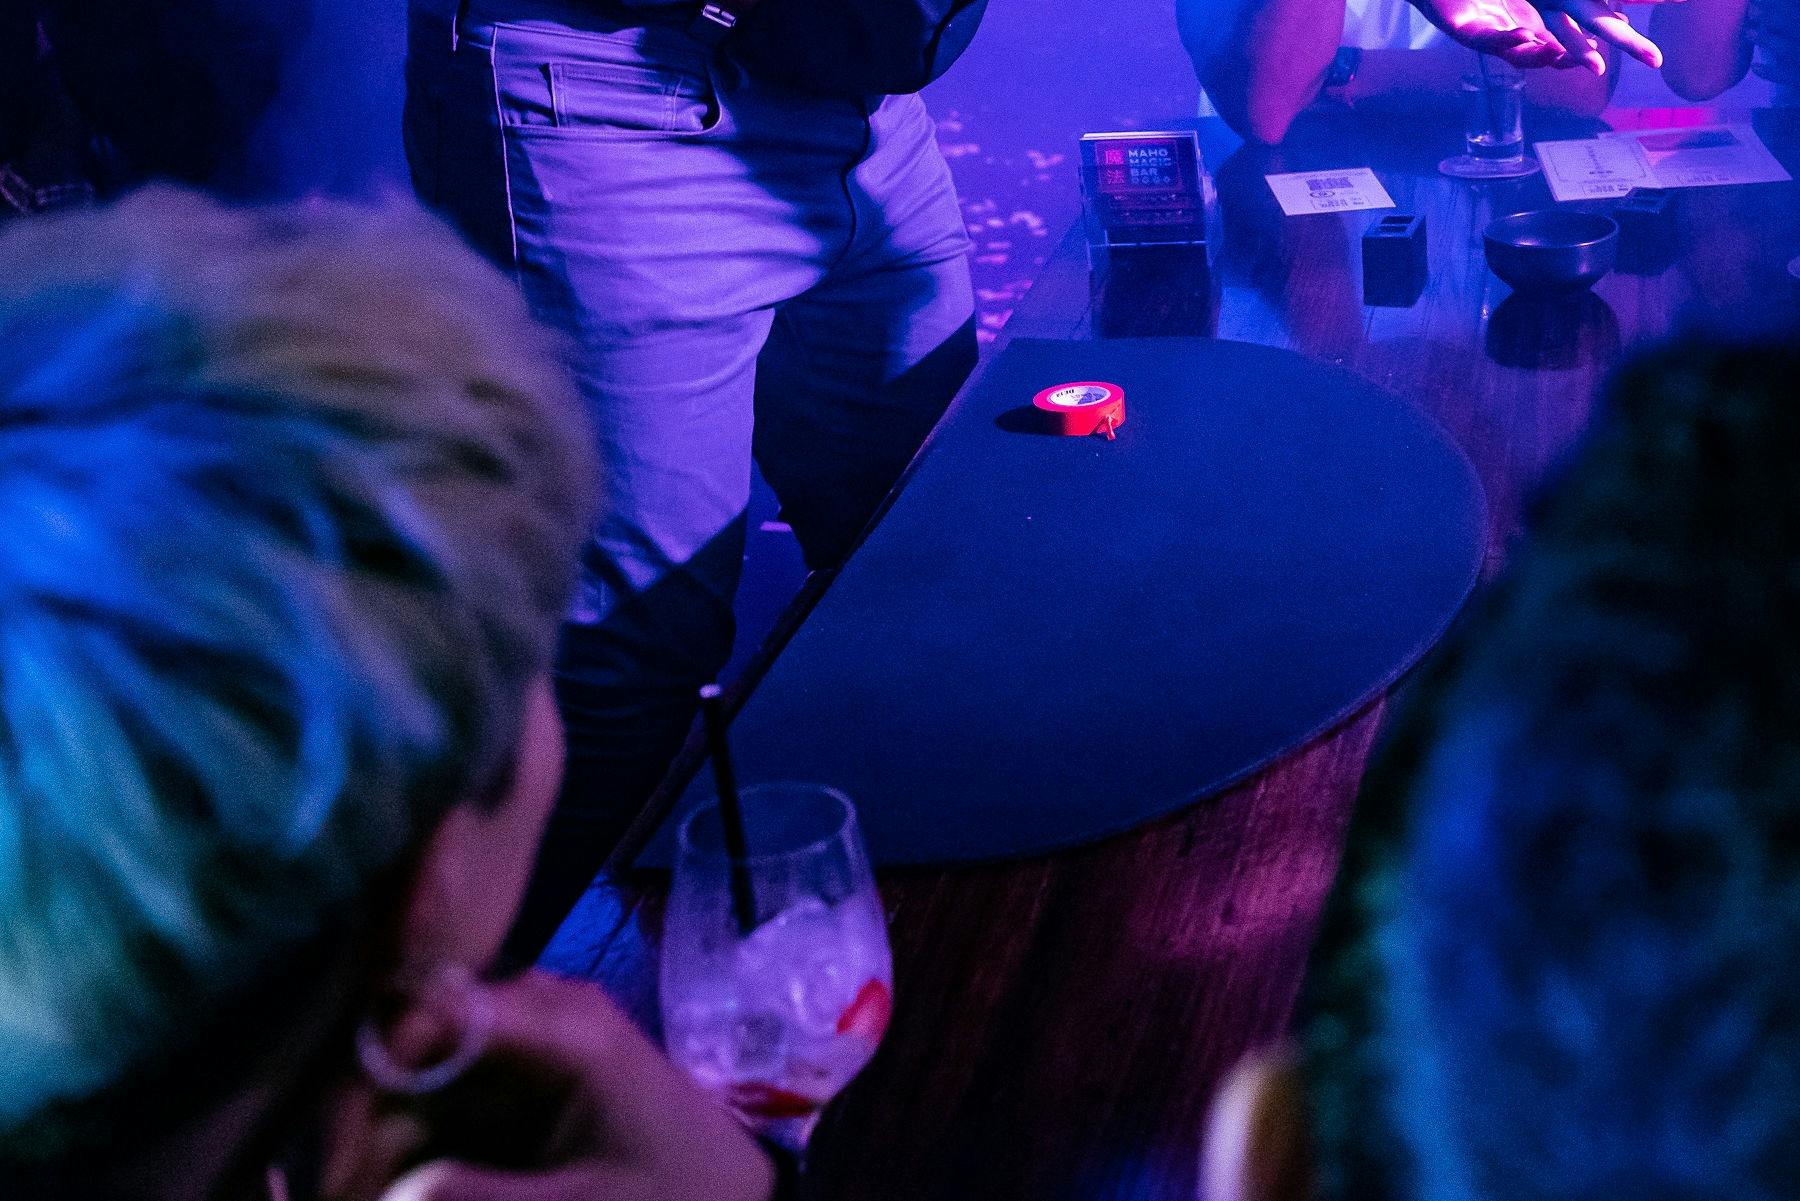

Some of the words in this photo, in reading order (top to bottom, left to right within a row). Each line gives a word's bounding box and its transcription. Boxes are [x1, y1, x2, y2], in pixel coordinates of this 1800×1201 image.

[1128, 149, 1168, 157] MAHO
[1129, 158, 1171, 166] MAGIC
[1130, 168, 1158, 176] BAR
